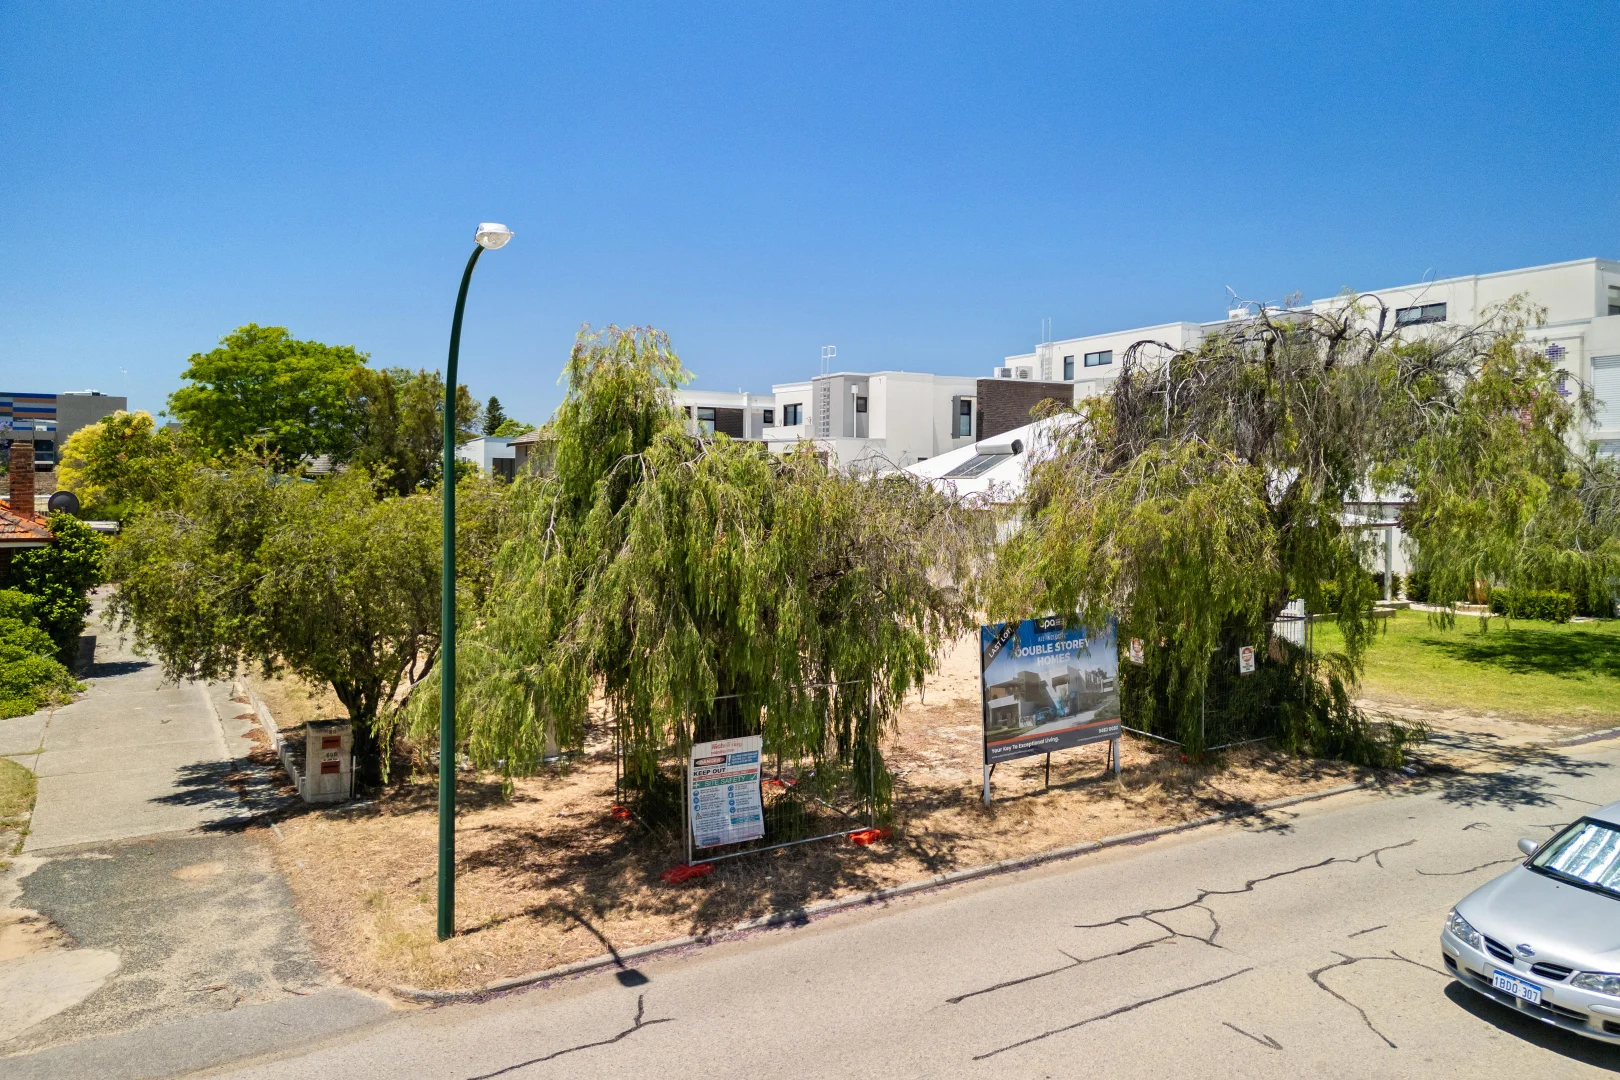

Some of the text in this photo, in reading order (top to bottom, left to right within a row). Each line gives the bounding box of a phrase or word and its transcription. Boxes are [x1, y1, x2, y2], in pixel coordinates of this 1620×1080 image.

[989, 641, 1002, 658] LAST
[1015, 638, 1090, 658] DOUBLE STOREY
[1037, 652, 1071, 666] HOMES
[1018, 738, 1045, 749] Exceptional
[720, 775, 746, 785] SAFETY
[1522, 986, 1538, 1001] 307
